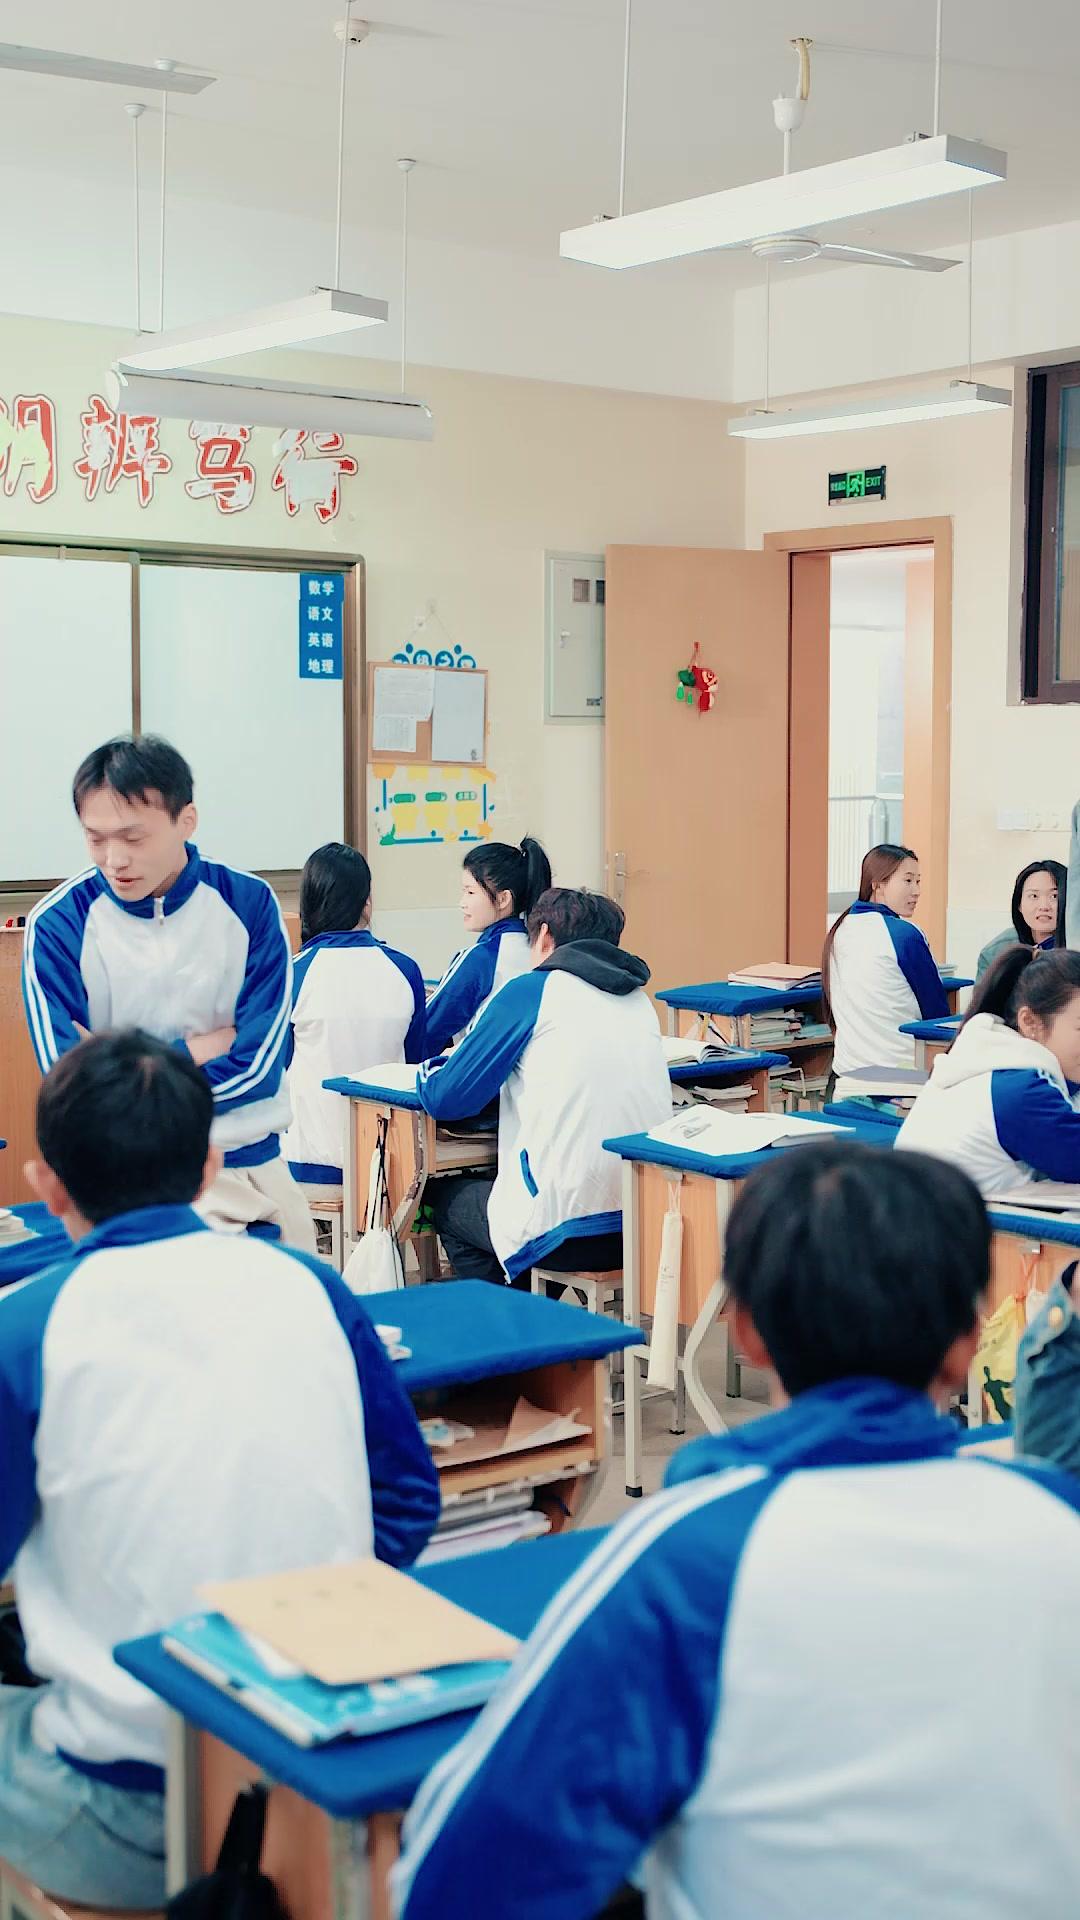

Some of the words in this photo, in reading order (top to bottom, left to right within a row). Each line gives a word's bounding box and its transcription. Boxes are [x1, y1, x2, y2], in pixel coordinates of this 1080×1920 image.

[866, 476, 881, 487] EXIT
[307, 580, 335, 596] 数学
[307, 606, 334, 622] 语文
[307, 632, 334, 648] 英语
[307, 658, 335, 674] 地理
